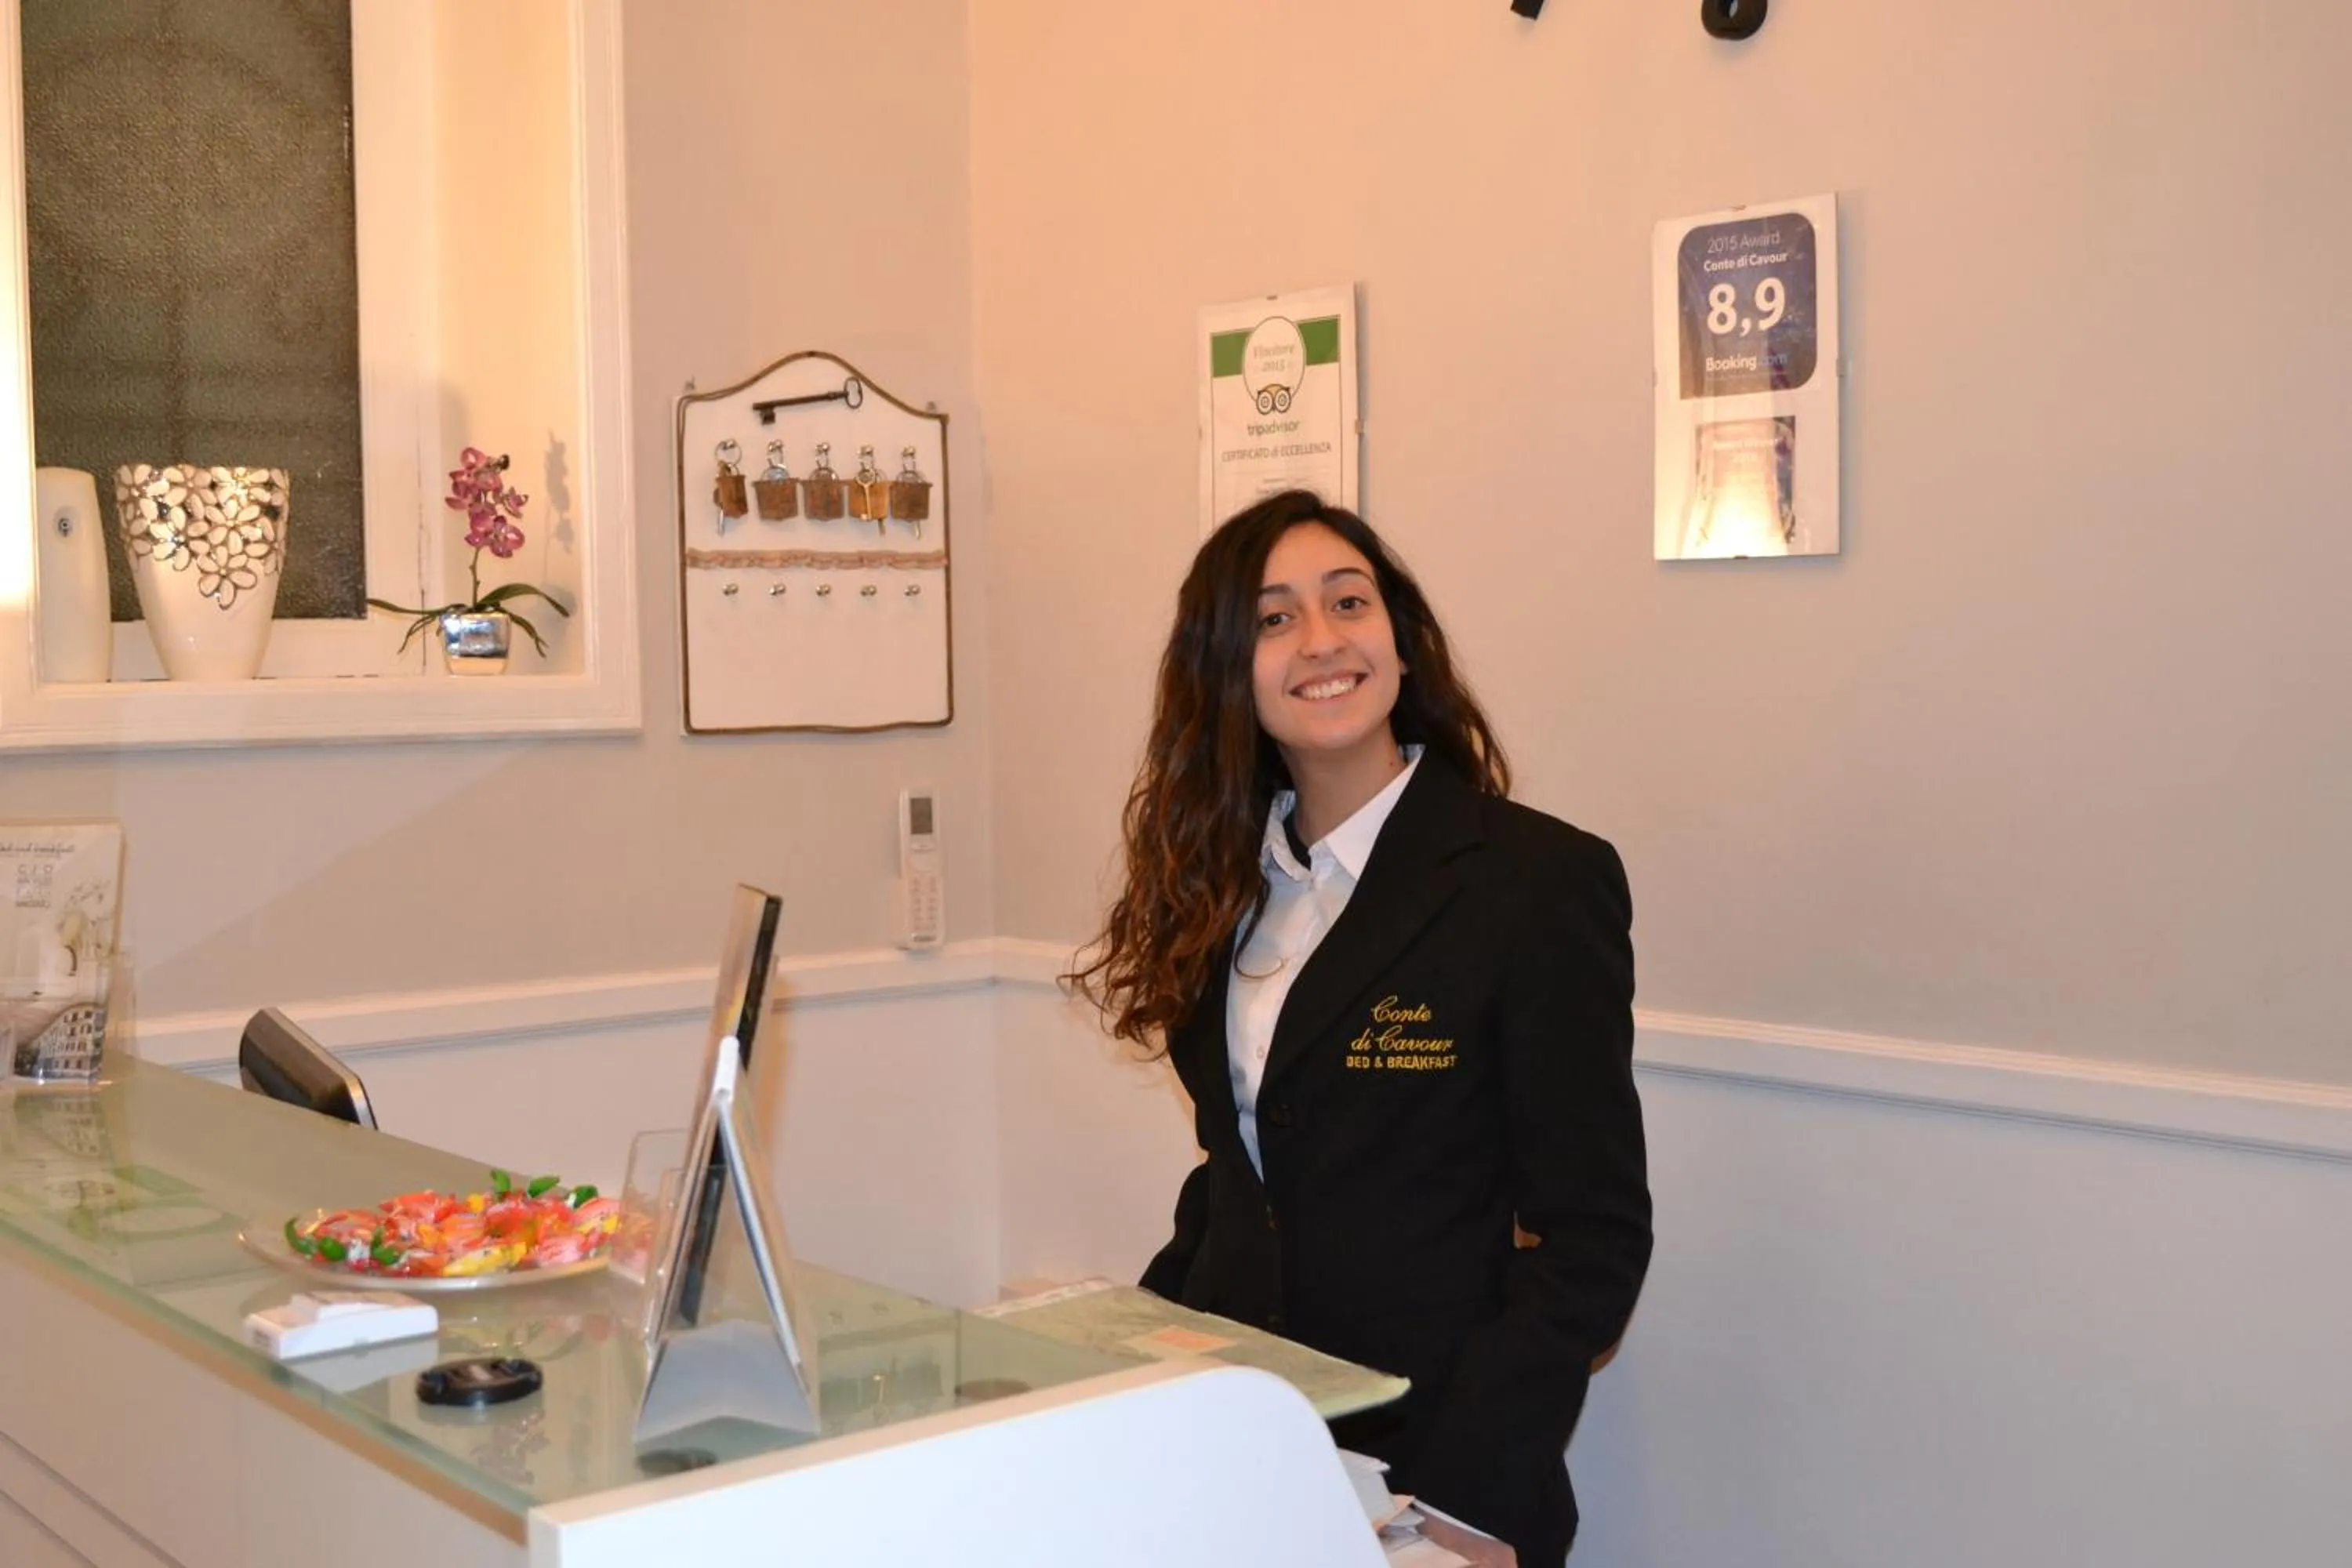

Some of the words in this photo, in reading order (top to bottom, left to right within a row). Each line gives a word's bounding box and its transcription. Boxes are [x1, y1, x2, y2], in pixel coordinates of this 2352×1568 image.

[1706, 235, 1738, 255] 2015
[1740, 230, 1781, 249] Award
[1703, 258, 1736, 272] Conte
[1737, 254, 1748, 267] di
[1749, 252, 1788, 267] Cavour
[1706, 277, 1786, 337] 8,9
[1247, 419, 1301, 437] tripadvisor
[1370, 995, 1431, 1022] Conte
[1350, 1027, 1374, 1051] di
[1374, 1024, 1454, 1052] Cavour
[1346, 1055, 1370, 1069] BED
[1374, 1055, 1384, 1069] &
[1386, 1054, 1459, 1071] BREAKFAST
